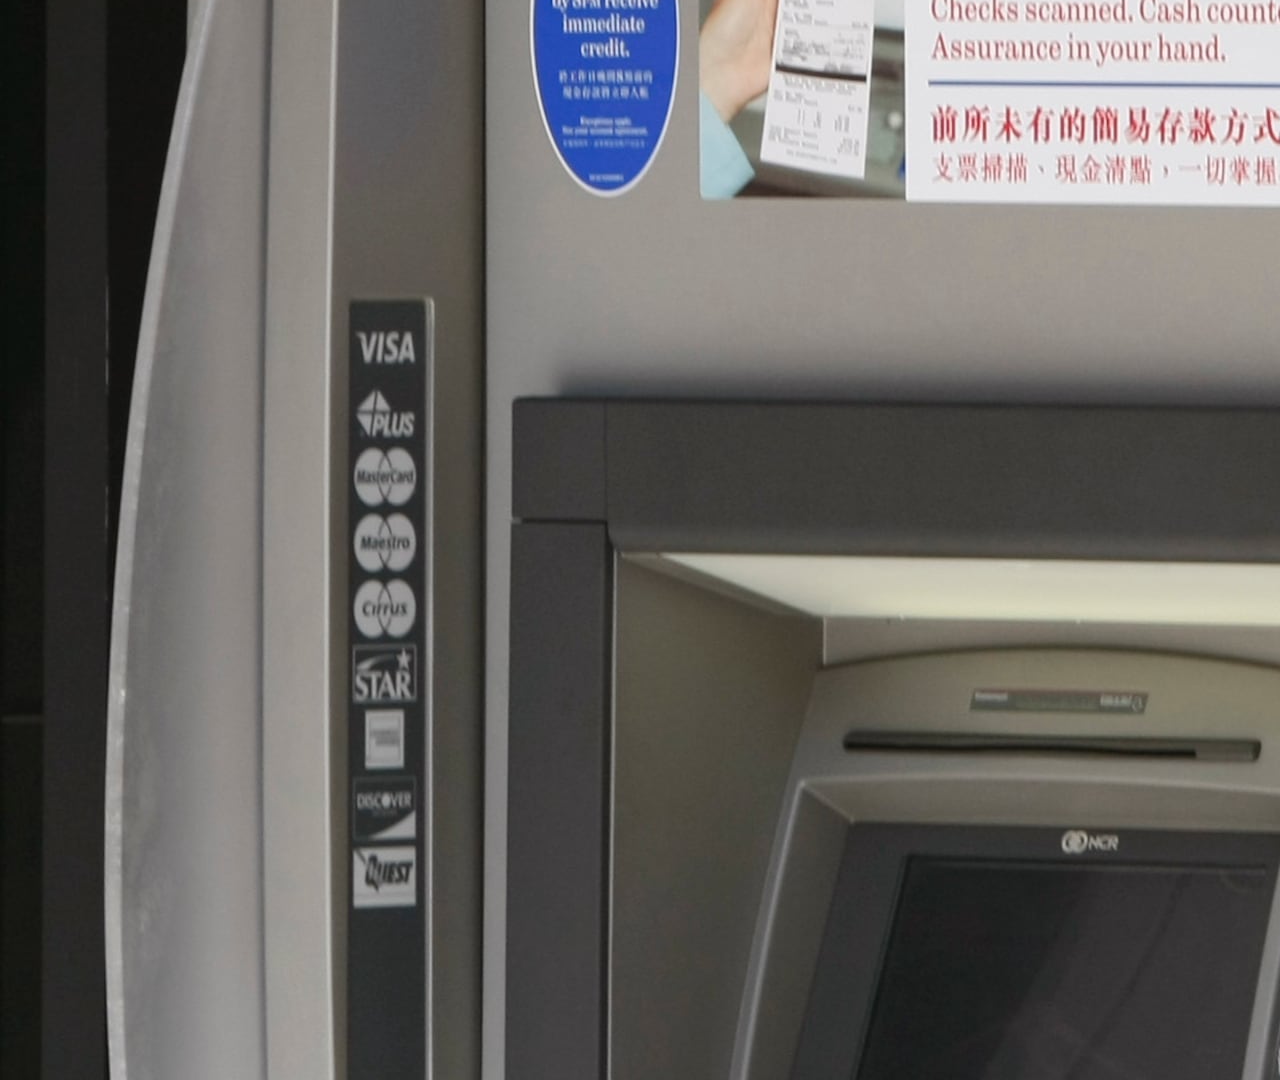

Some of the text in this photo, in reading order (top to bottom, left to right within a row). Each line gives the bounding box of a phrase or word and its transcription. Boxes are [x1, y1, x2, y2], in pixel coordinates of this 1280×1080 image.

[563, 13, 645, 34] immediate
[580, 38, 630, 58] credit.
[931, 32, 1226, 67] Assurance in your hand.
[355, 331, 416, 363] VISA
[372, 412, 415, 438] PLUS
[357, 471, 413, 484] MasterCard
[360, 535, 410, 550] Maestro
[362, 601, 407, 617] Cirrus
[356, 670, 411, 700] STAR
[357, 792, 411, 810] DISCOVER
[1089, 834, 1119, 850] NCR
